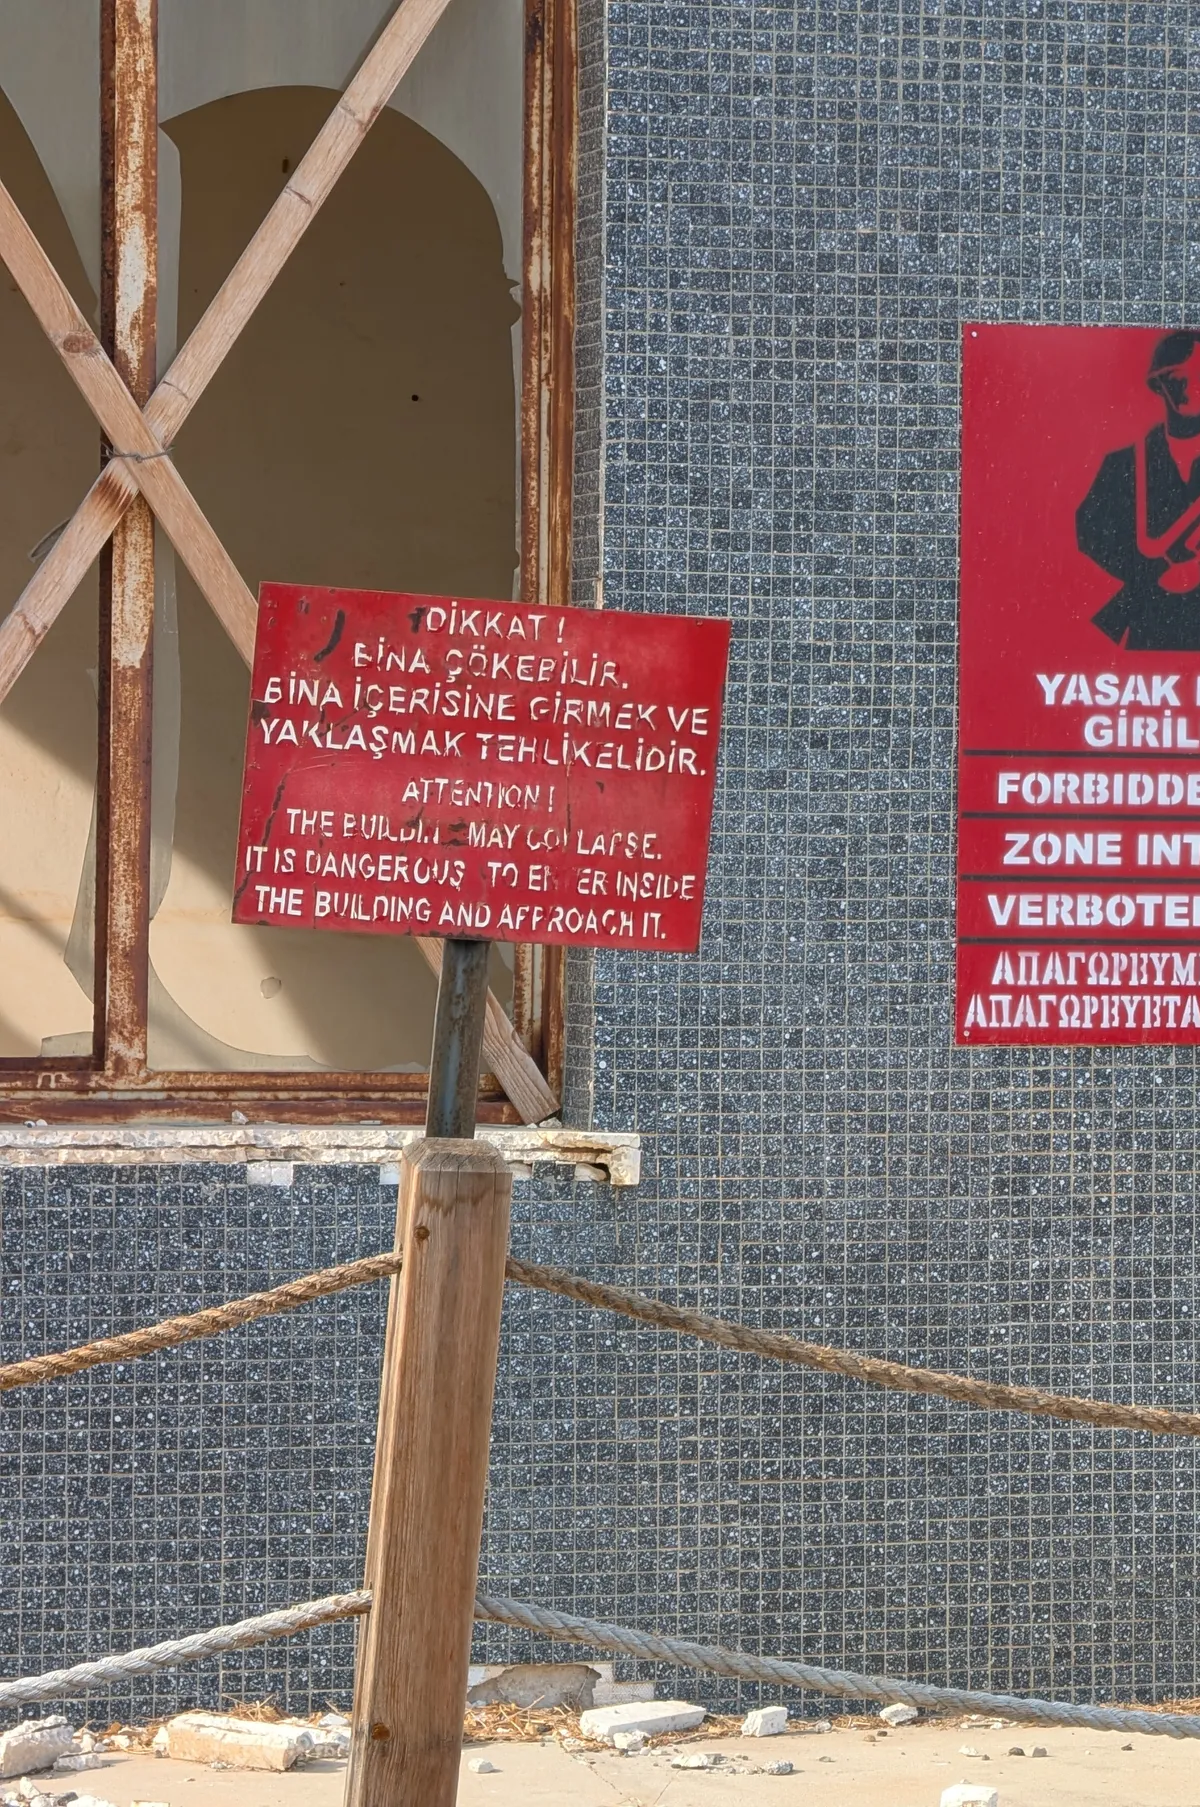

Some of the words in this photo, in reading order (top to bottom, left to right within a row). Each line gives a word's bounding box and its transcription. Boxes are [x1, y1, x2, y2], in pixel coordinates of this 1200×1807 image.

[263, 671, 344, 709] BİNA
[354, 676, 516, 721] İÇERİSİNE
[529, 691, 657, 731] GİRMEK
[667, 705, 710, 735] VE
[1036, 673, 1181, 706] YASAK
[261, 718, 466, 760] YAKLAŞMAK
[476, 732, 707, 776] TEHLİKELİDİR.
[286, 808, 335, 838] THE
[468, 821, 521, 850] MAY
[1003, 832, 1122, 865] ZONE
[245, 846, 268, 873] IT
[274, 848, 296, 874] IS
[305, 850, 466, 889] DANGEROUS
[487, 861, 519, 888] TO
[616, 870, 695, 901] INSIDE
[255, 885, 304, 916] THE
[315, 891, 431, 923] BUILDING
[438, 901, 491, 928] AND
[642, 911, 666, 940] IT.
